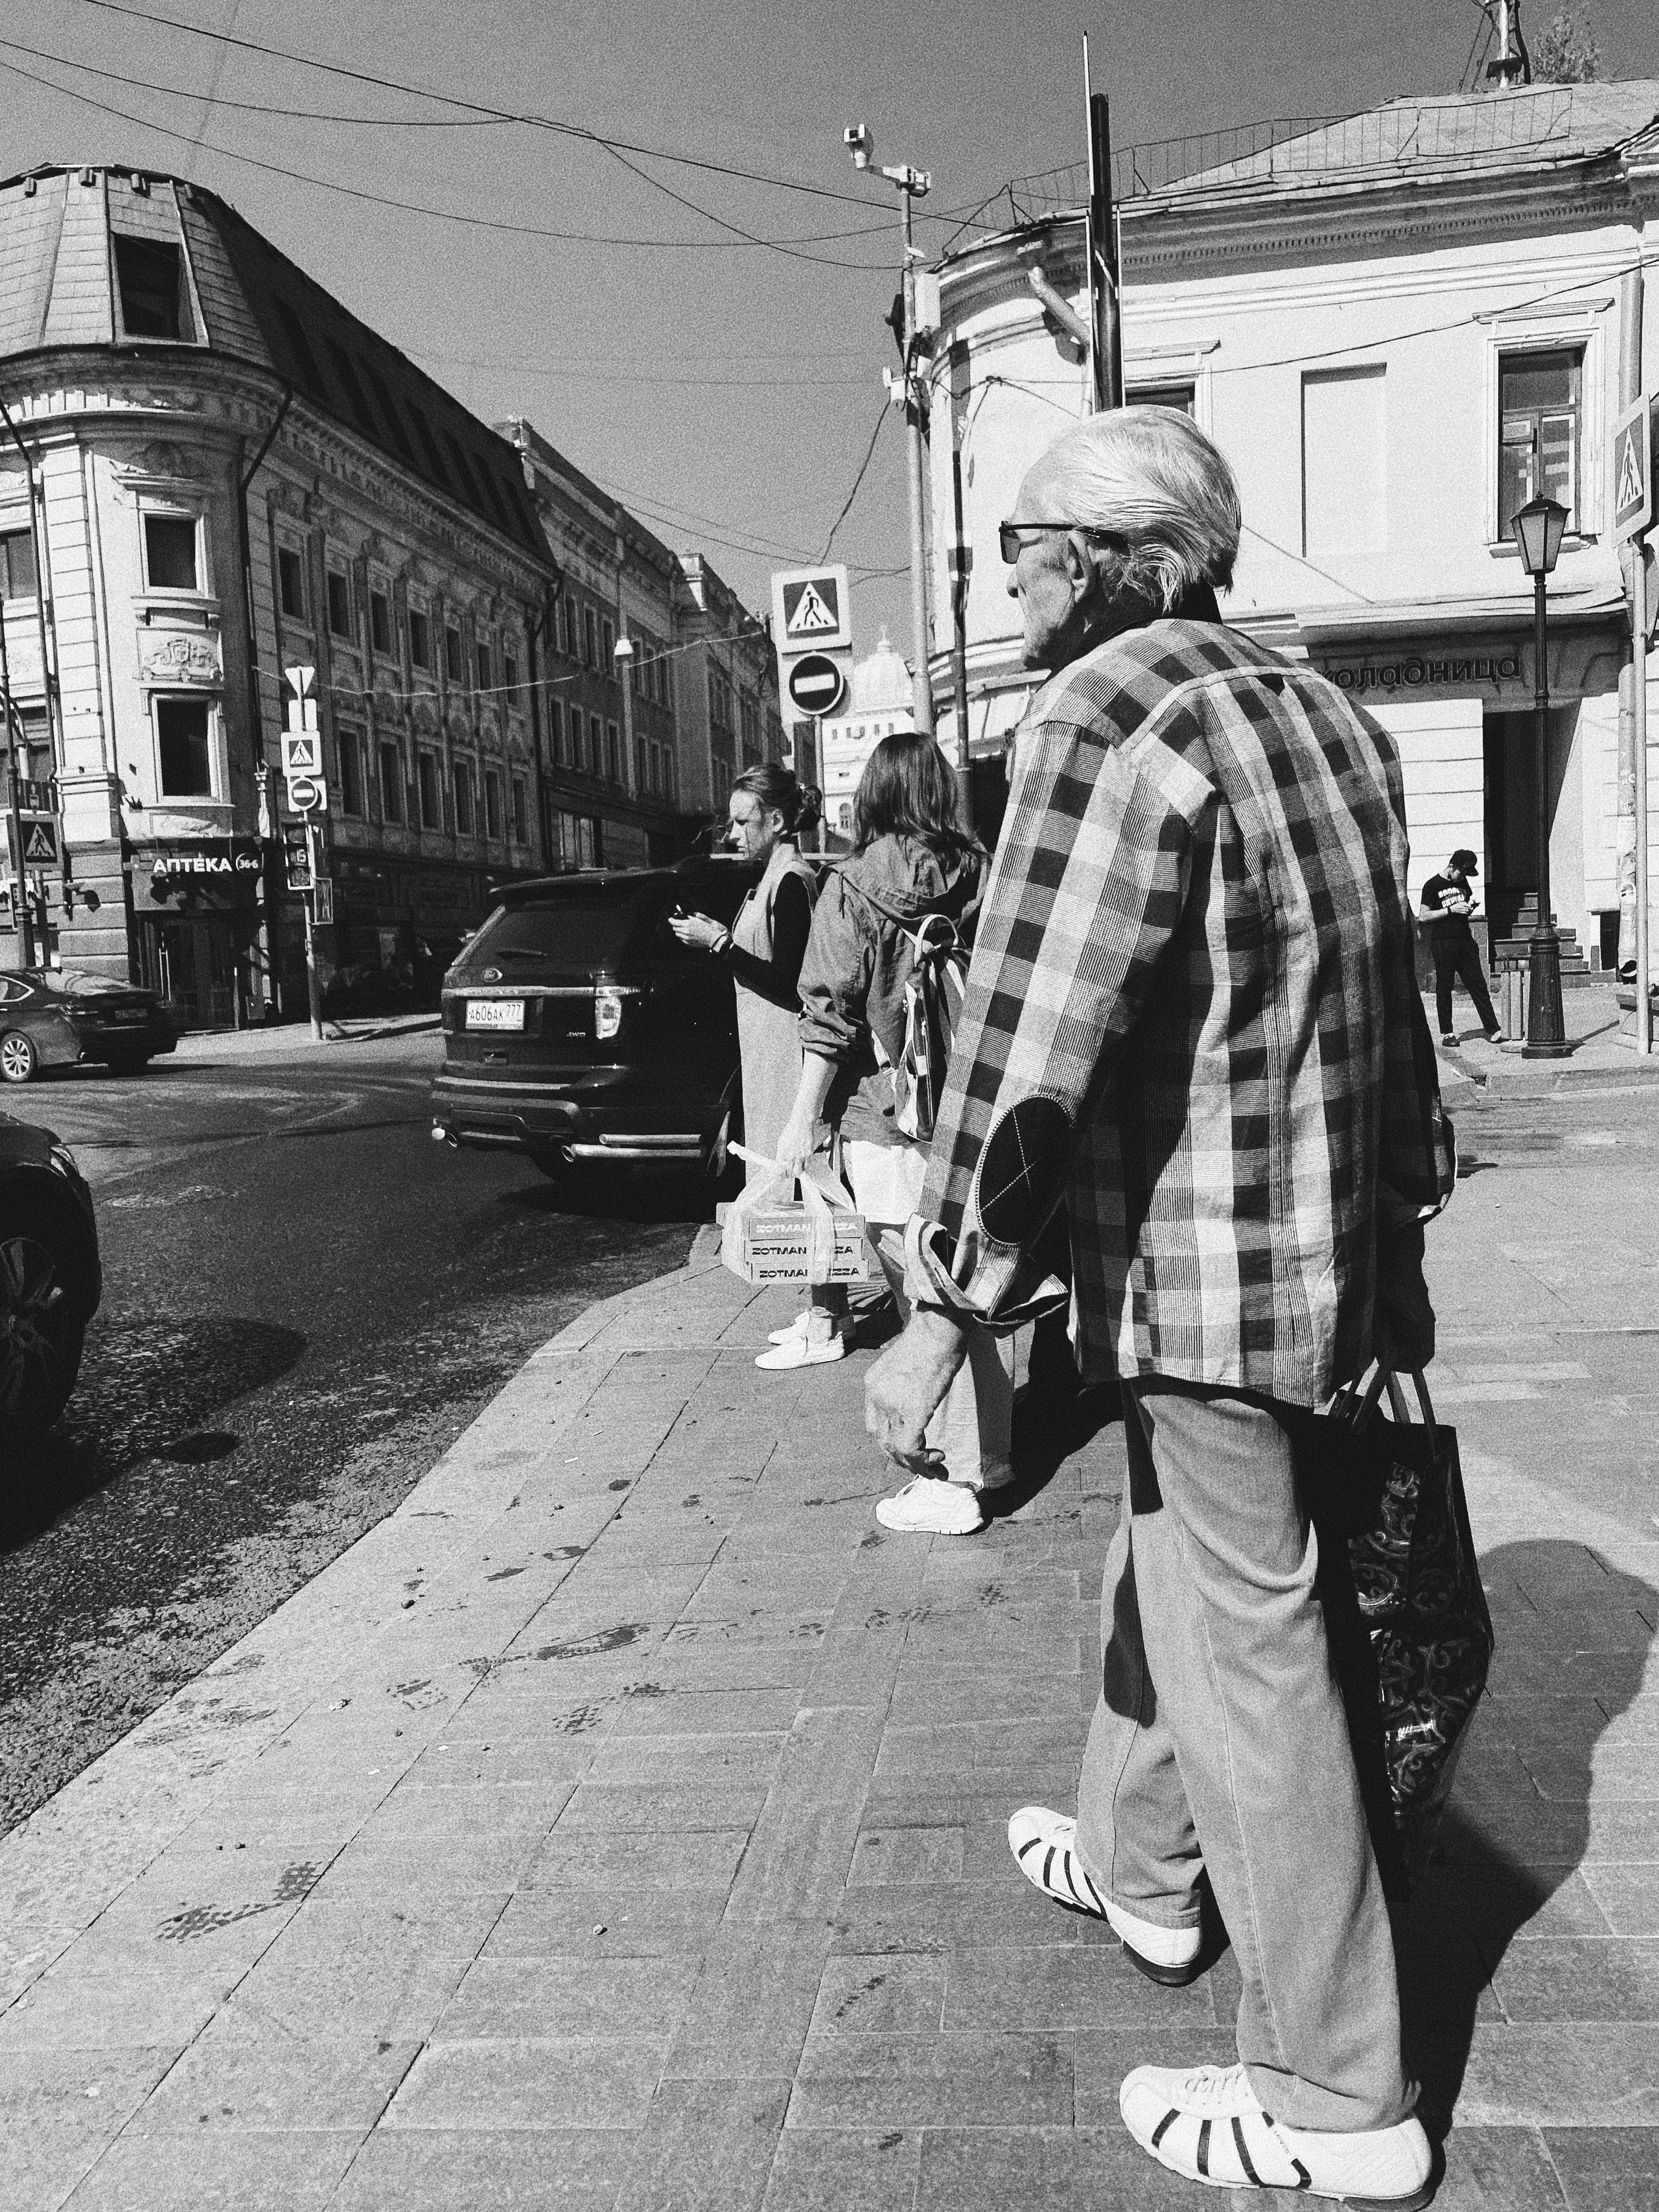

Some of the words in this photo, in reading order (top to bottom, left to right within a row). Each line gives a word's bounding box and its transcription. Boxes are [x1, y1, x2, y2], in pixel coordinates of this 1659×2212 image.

[1316, 656, 1521, 690] коладница
[153, 857, 233, 873] АПТЕКА
[507, 1004, 520, 1017] 777
[752, 1246, 807, 1255] ZOTMAN
[829, 1267, 860, 1276] IZZA
